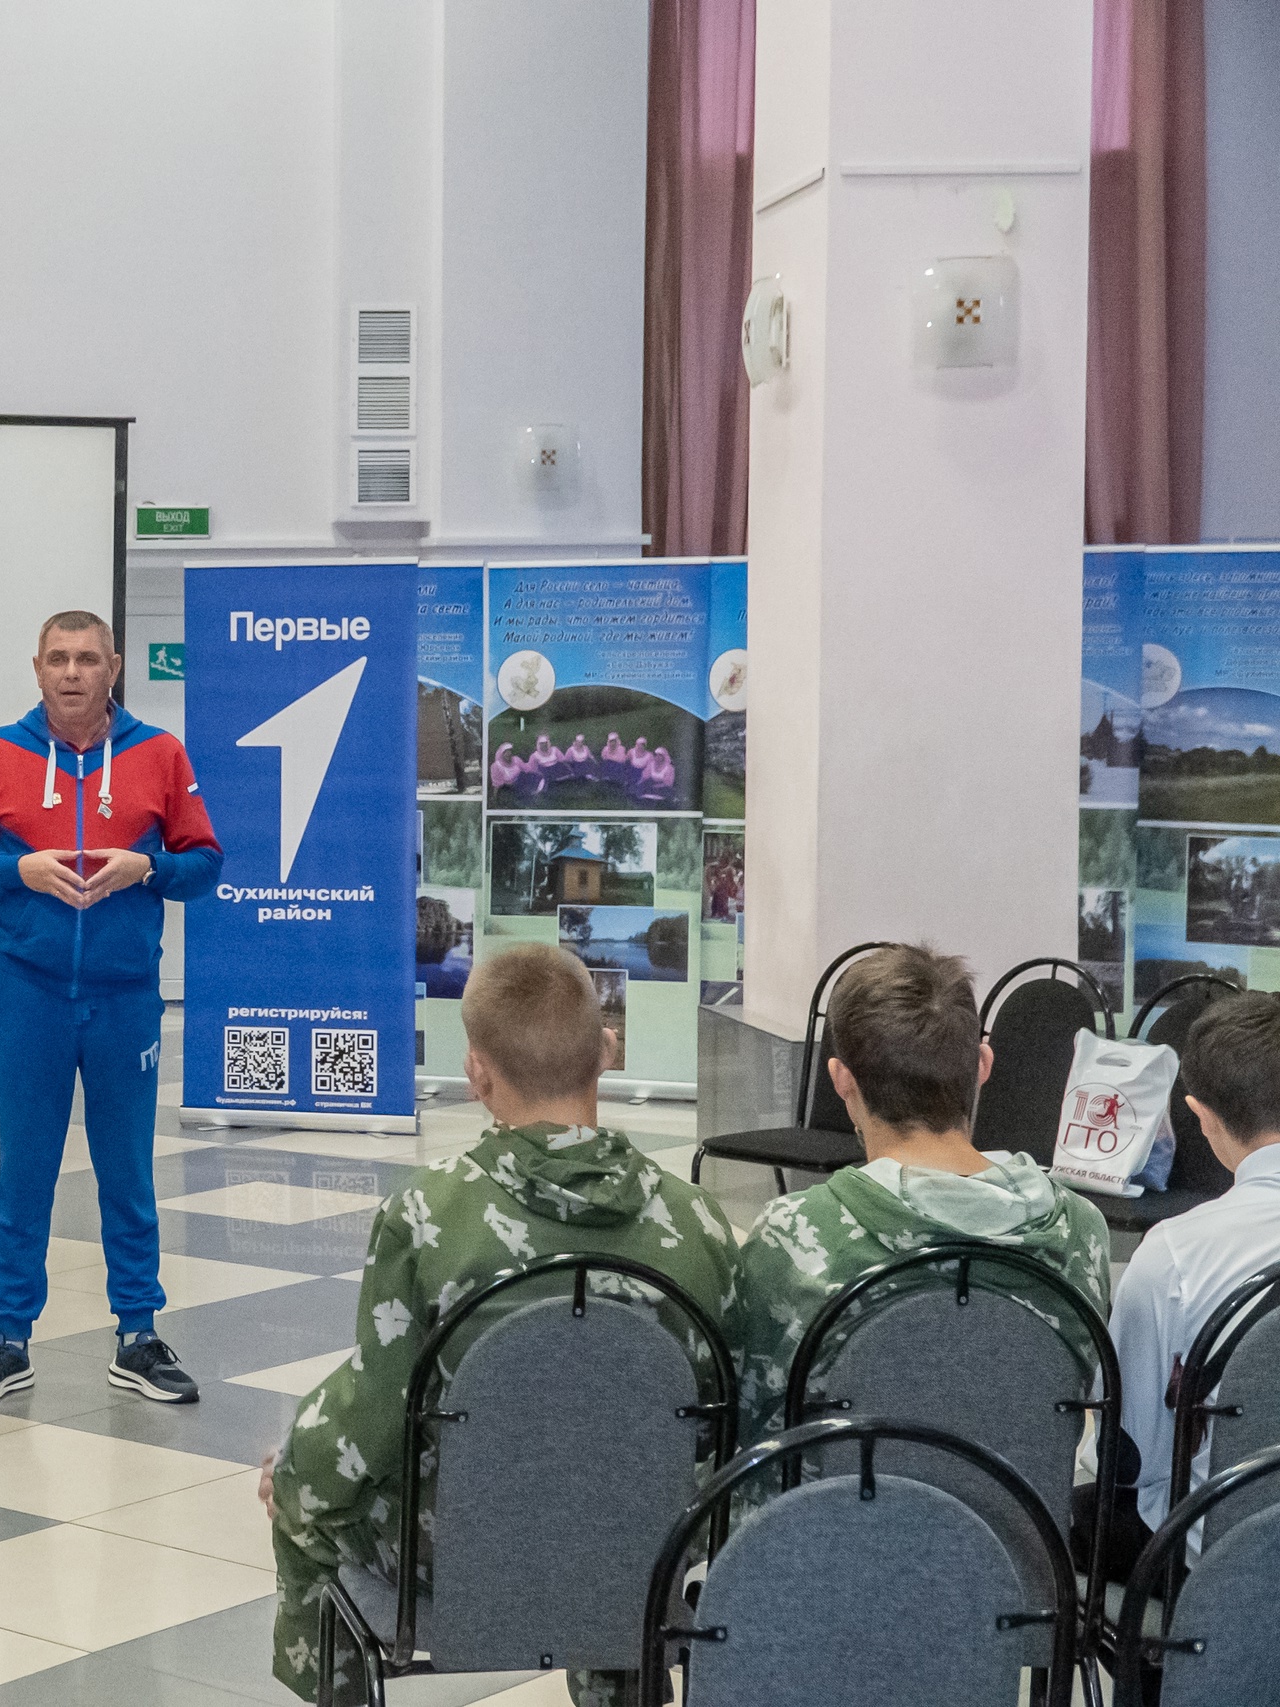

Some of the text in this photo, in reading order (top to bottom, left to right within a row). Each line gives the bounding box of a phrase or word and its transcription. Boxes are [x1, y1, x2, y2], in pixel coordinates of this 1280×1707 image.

[156, 511, 190, 524] ВЫХОД
[163, 524, 184, 532] EXIT
[514, 582, 535, 593] Для
[539, 580, 579, 591] России
[583, 582, 608, 591] село
[504, 599, 511, 609] А
[516, 598, 535, 609] для
[578, 594, 662, 609] родительский
[494, 616, 503, 626] И
[506, 617, 523, 625] мы
[568, 615, 589, 625] что
[593, 614, 636, 624] можем
[230, 611, 370, 651] Первые
[503, 630, 539, 643] Малой
[599, 629, 621, 642] где
[623, 633, 643, 641] мы
[648, 630, 694, 642] живем!
[216, 883, 374, 903] Сухиничский
[258, 904, 331, 923] район
[228, 1006, 367, 1022] регистрируйся:
[315, 1100, 360, 1109] страничка
[361, 1101, 373, 1109] ВК
[1063, 1122, 1117, 1153] ГТО
